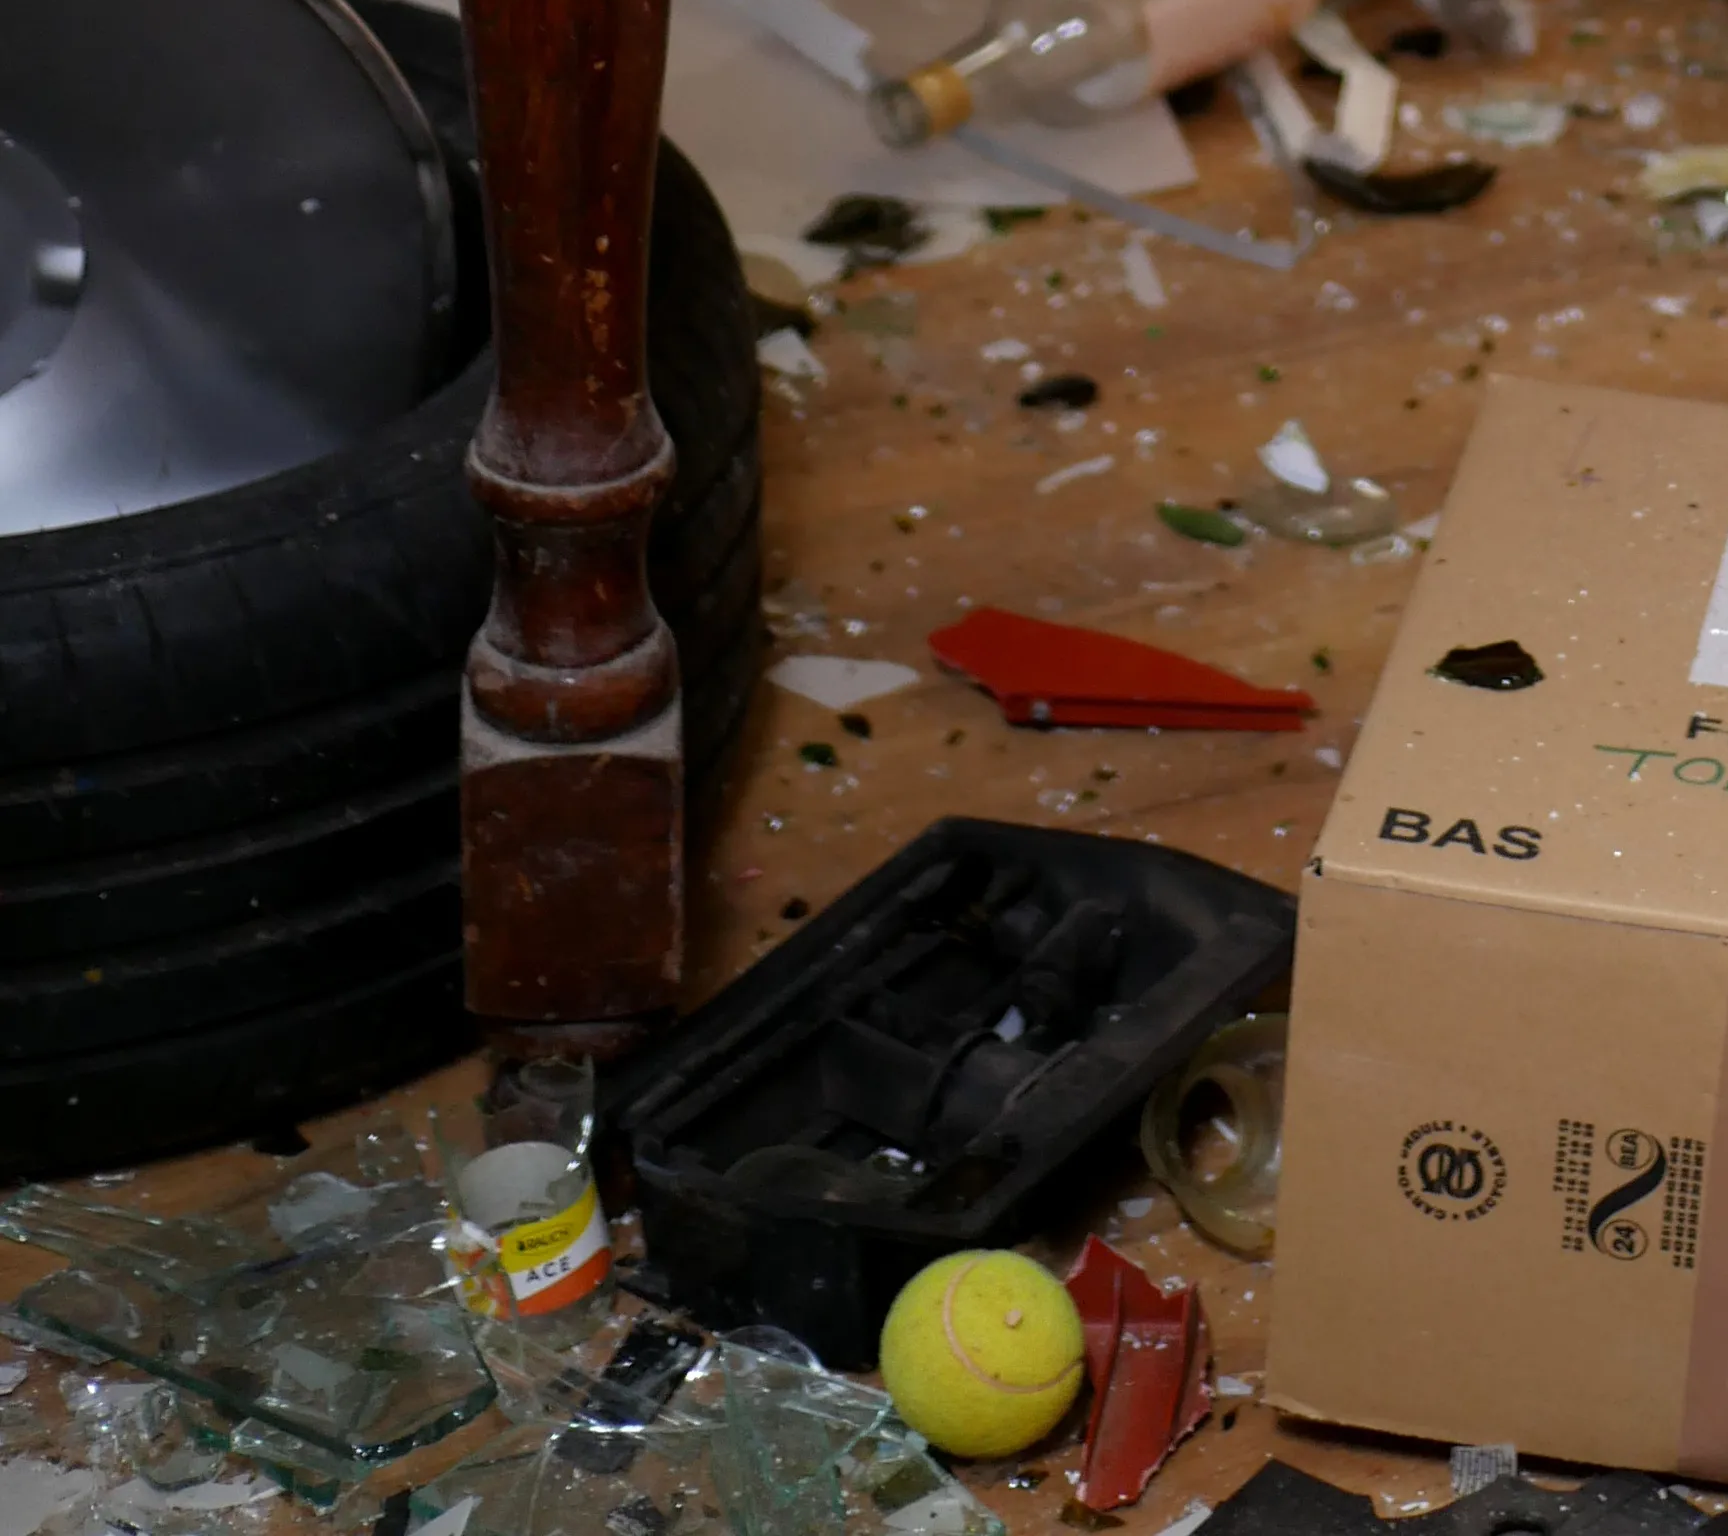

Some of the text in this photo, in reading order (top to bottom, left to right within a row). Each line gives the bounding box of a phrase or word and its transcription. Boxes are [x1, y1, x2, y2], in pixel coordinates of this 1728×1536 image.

[1377, 806, 1545, 862] BAS
[1612, 1225, 1637, 1254] 24
[526, 1256, 570, 1283] ACE
